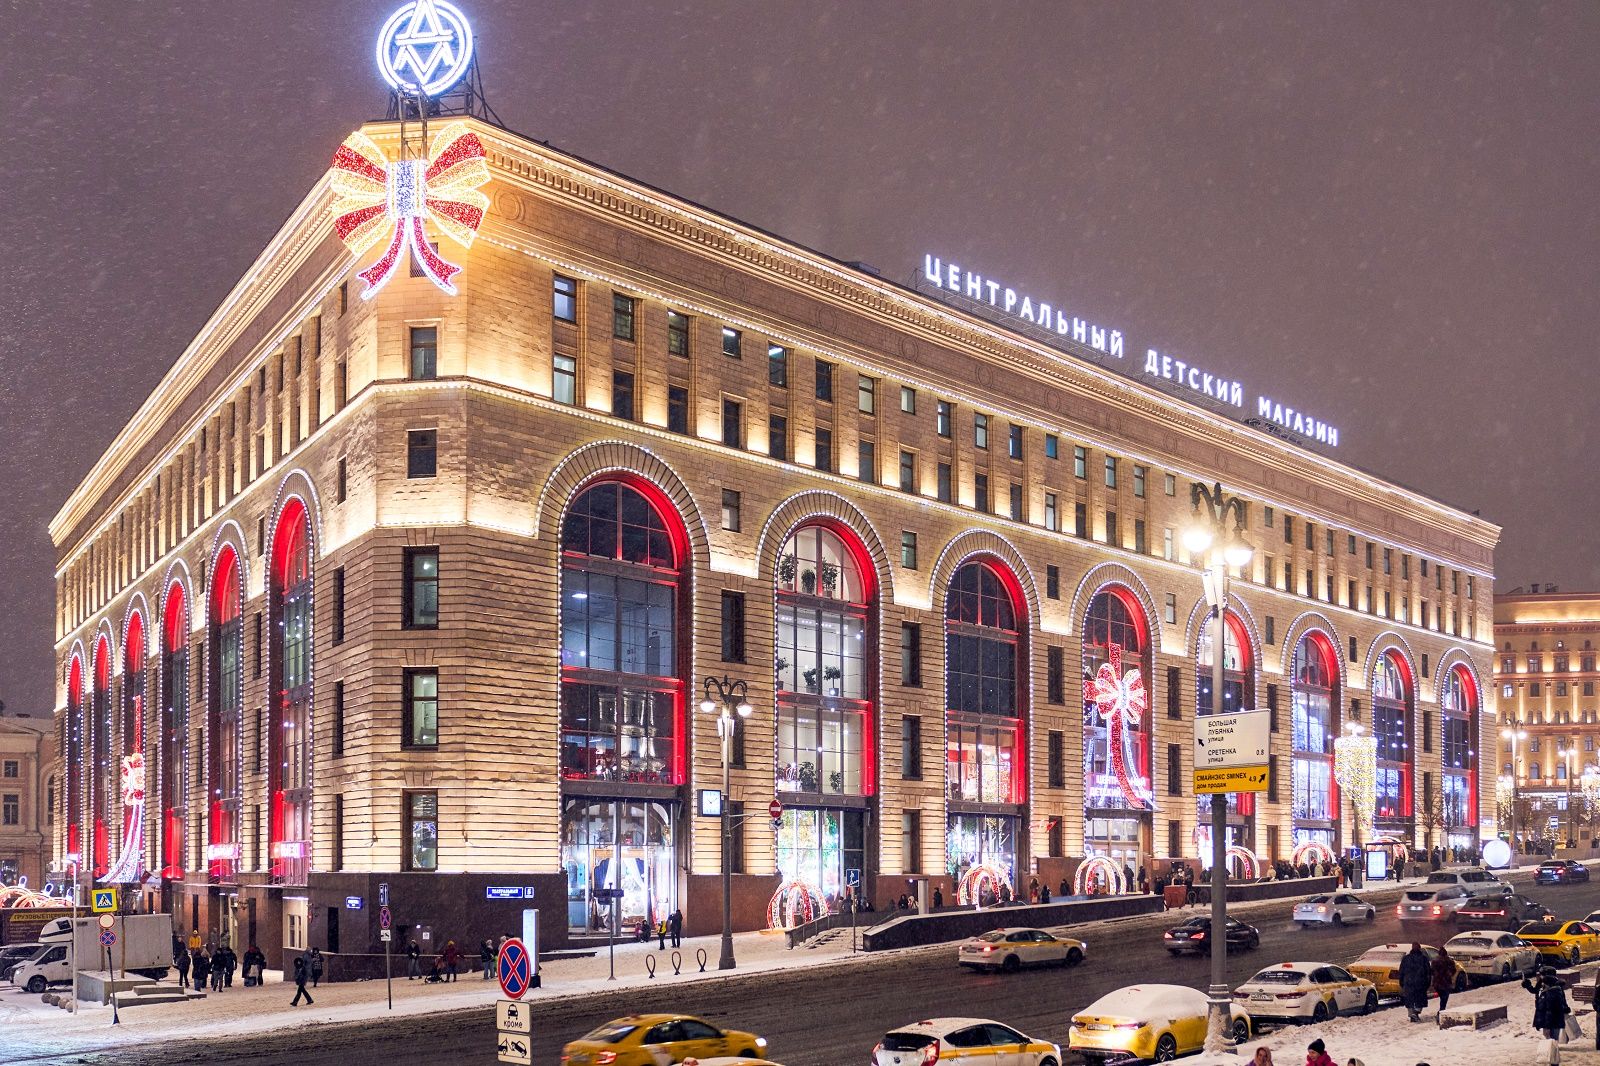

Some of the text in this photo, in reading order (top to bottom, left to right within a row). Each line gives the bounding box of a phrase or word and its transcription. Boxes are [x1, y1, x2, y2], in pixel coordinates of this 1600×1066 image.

[925, 253, 1338, 447] ЦЕНТРАЛЬНЫЙ ДЕТСКИЙ МАГАЗИН
[1208, 719, 1237, 727] БОЛЬШАЯ
[1208, 748, 1237, 756] СРЕТЕНКА
[1196, 773, 1225, 781] СМАЙНЭКС
[1226, 772, 1247, 780] SMINEX
[503, 1020, 523, 1029] кроме
